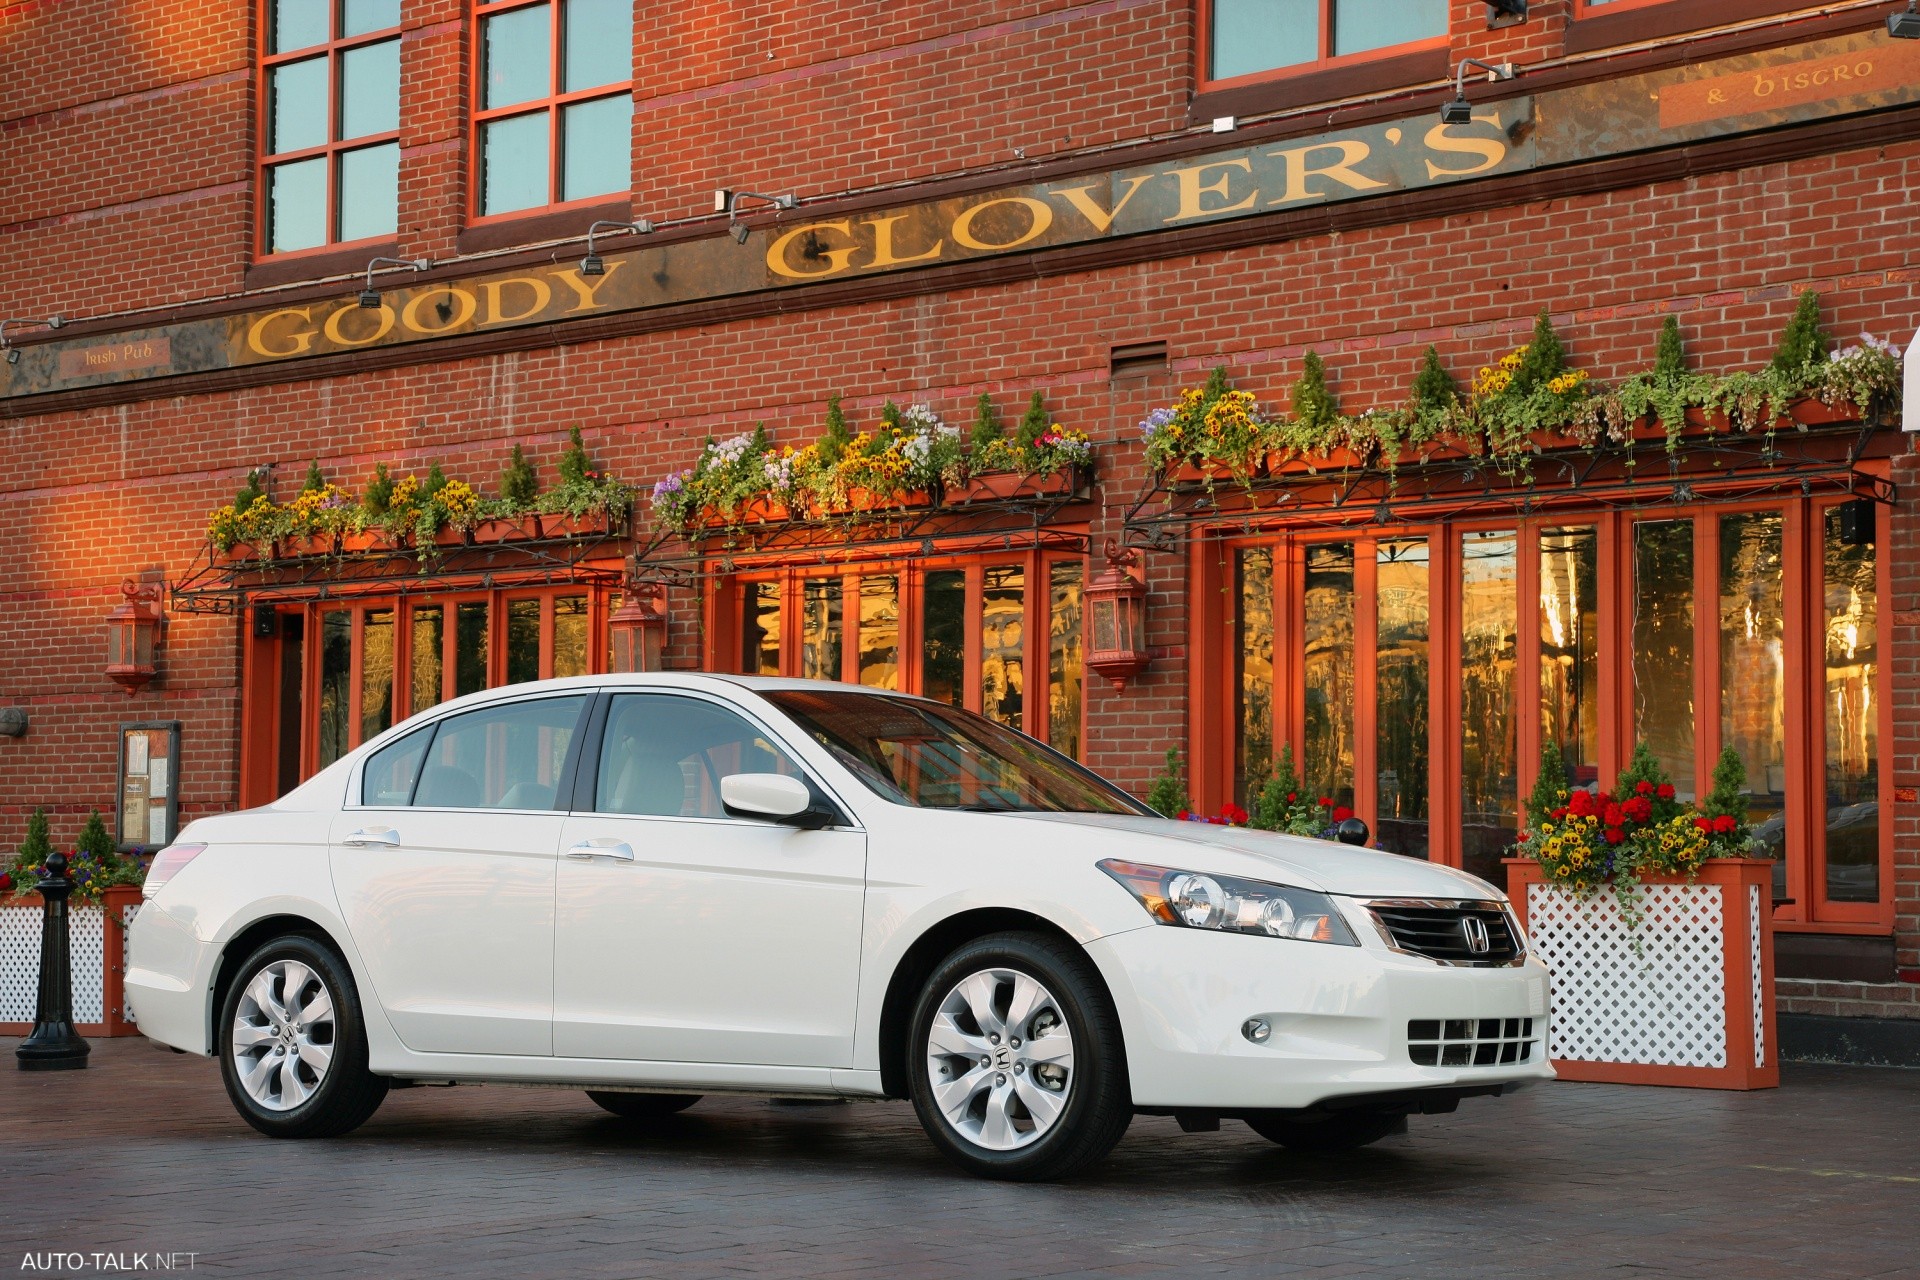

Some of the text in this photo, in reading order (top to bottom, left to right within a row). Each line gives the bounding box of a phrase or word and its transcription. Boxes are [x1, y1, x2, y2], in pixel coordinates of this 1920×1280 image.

[1707, 88, 1728, 104] &
[248, 114, 1507, 356] GOODY GLOVER'S
[124, 344, 152, 360] Pub
